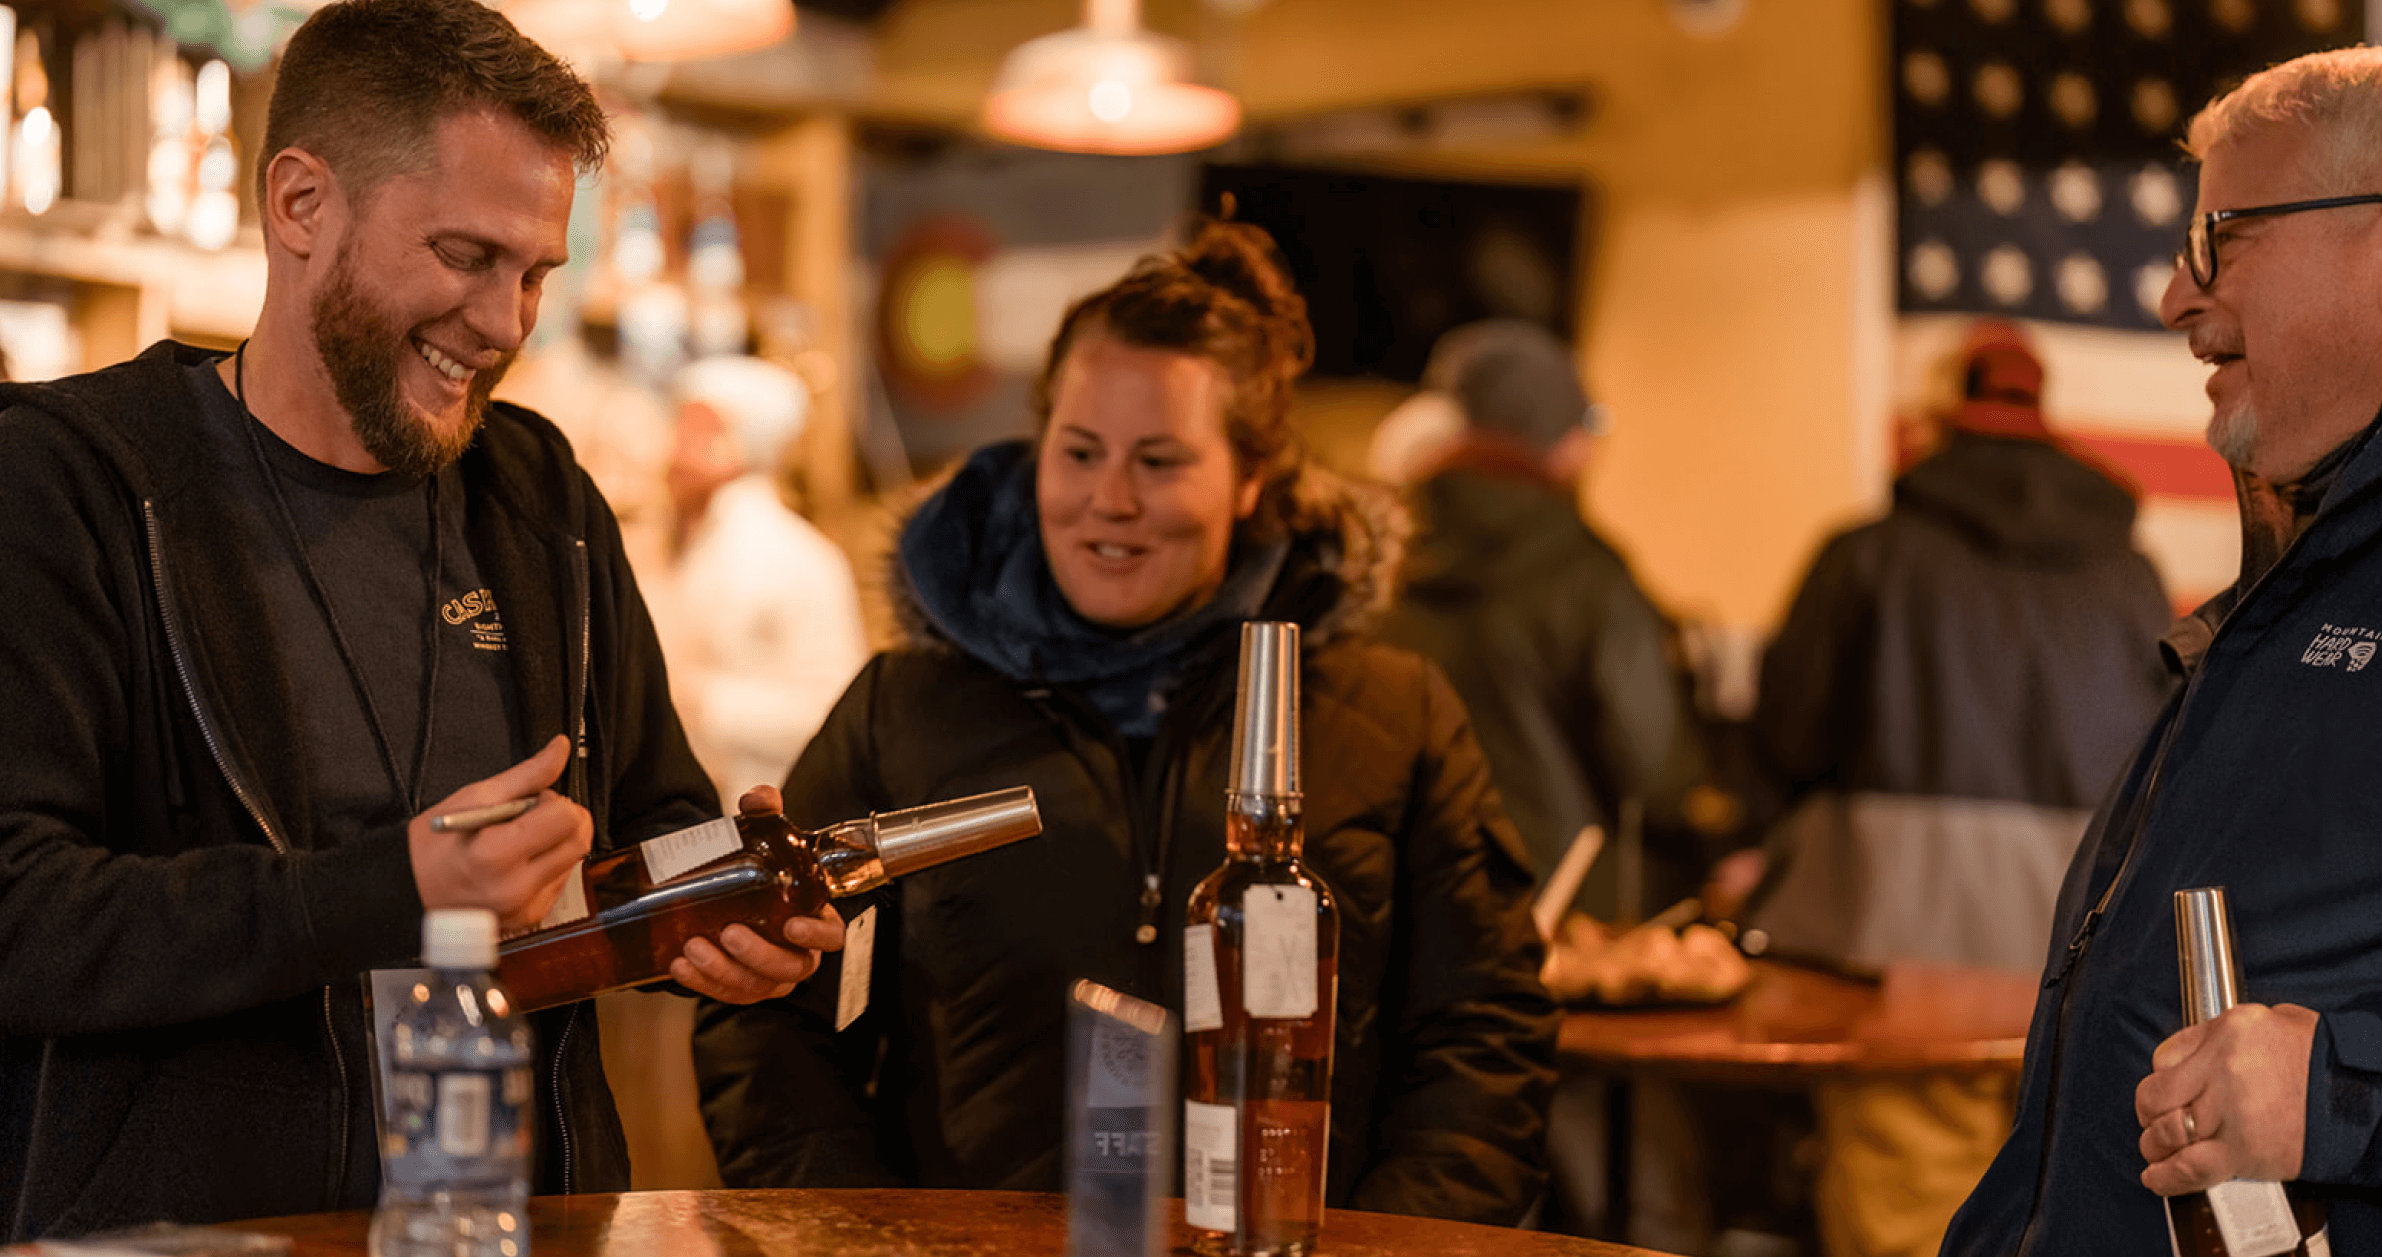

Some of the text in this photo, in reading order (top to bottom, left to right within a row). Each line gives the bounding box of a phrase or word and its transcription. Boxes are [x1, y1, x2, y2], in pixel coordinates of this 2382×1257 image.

[2321, 623, 2382, 640] MOUNTAI
[2308, 633, 2353, 651] HARD
[2300, 649, 2343, 667] WEAR
